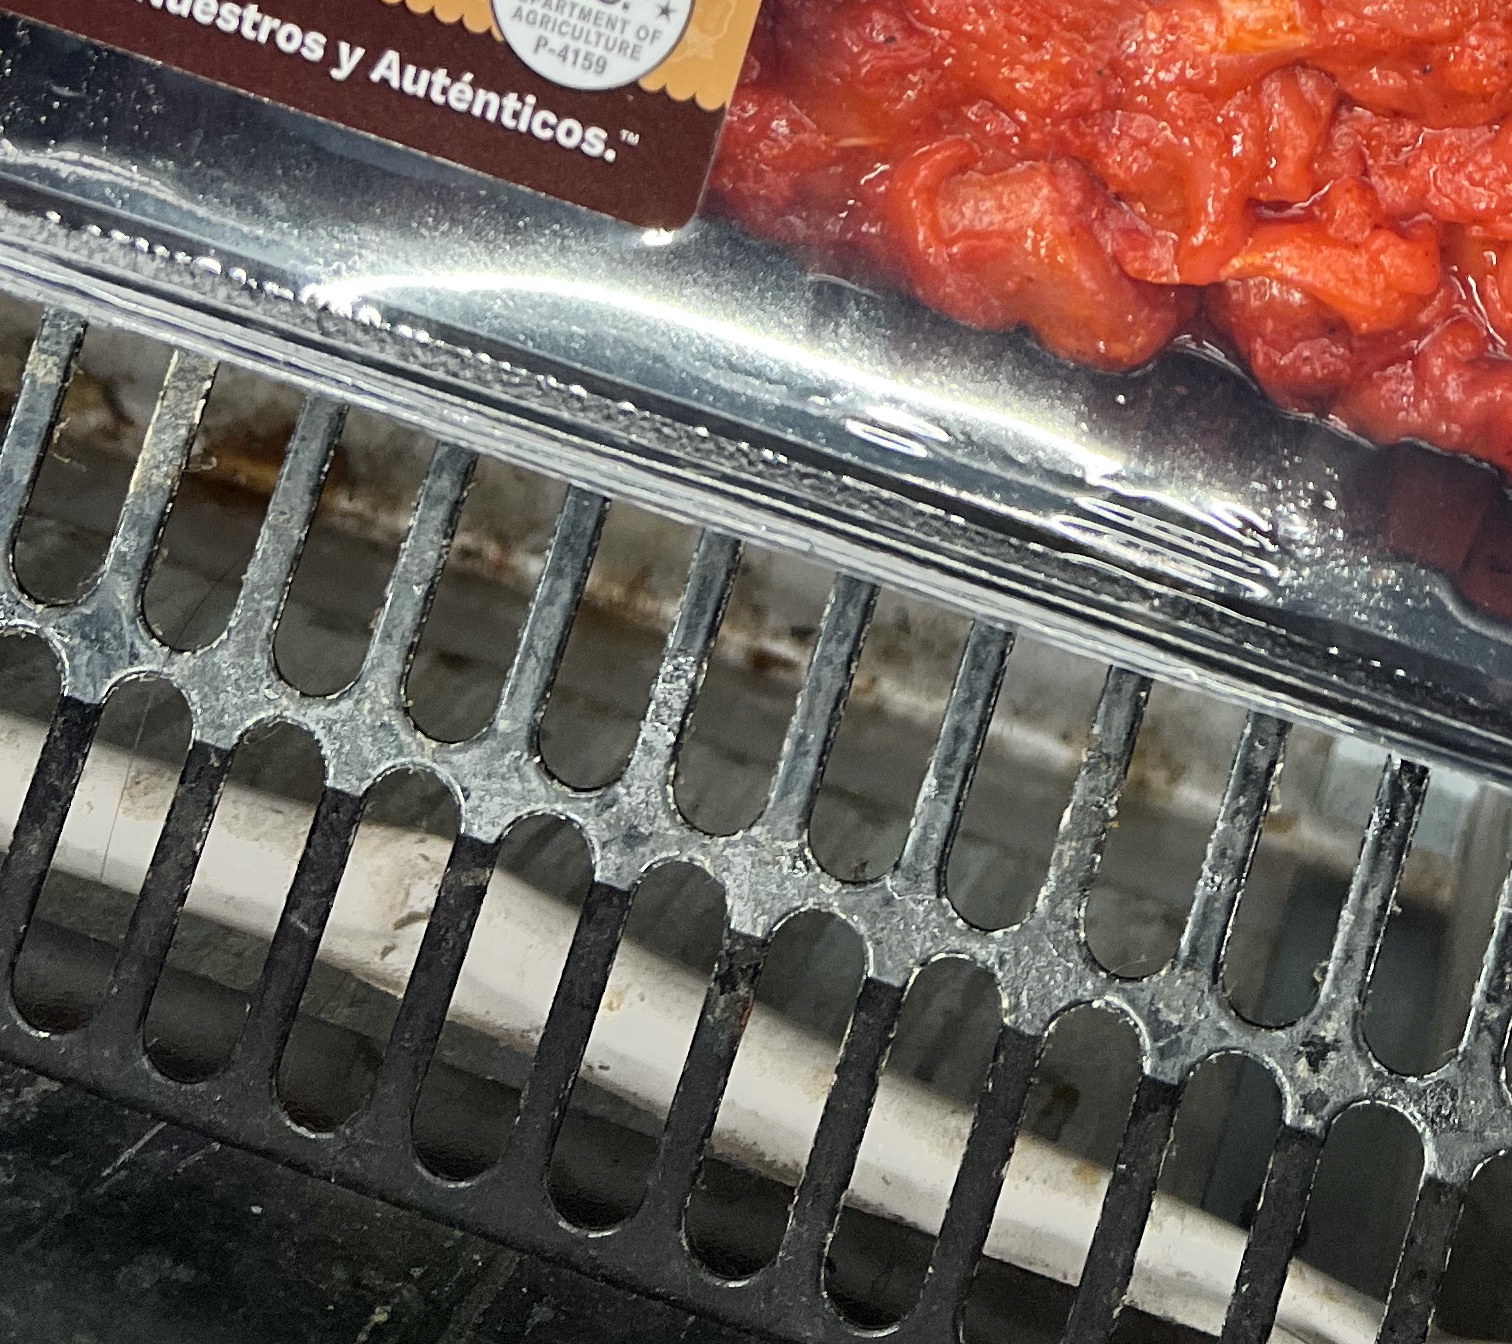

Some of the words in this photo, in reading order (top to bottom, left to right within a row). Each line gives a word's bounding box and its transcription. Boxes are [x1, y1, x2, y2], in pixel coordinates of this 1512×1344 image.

[511, 5, 643, 61] AGRICULTURE
[636, 25, 663, 45] OF
[329, 40, 365, 80] y
[533, 35, 609, 76] P-4159
